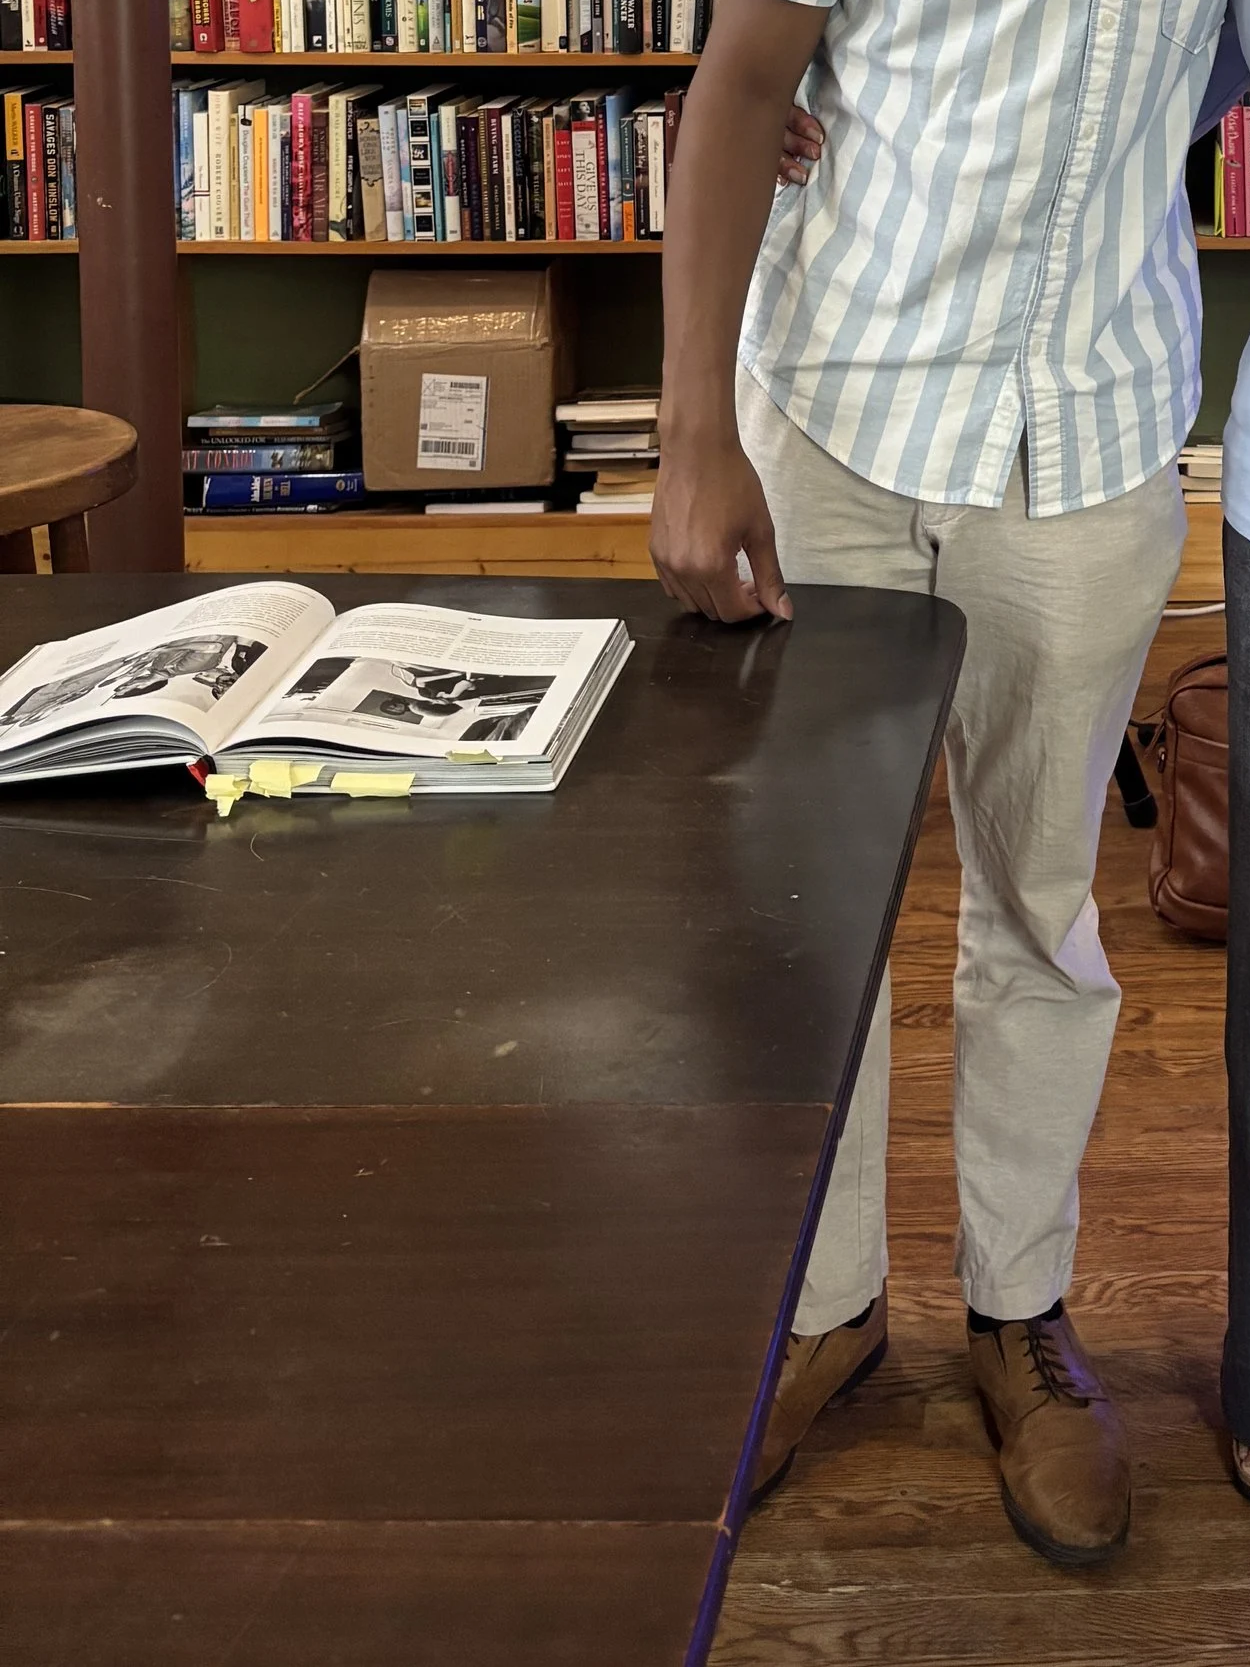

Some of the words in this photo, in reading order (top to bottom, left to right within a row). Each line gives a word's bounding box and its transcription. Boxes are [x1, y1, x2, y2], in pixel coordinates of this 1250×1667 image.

[46, 114, 56, 155] SAVAGES
[242, 130, 250, 154] Douglas
[47, 158, 56, 177] DON
[575, 152, 586, 182] THIS
[585, 161, 596, 192] GIVE
[48, 182, 58, 222] WINSLOW
[577, 184, 587, 210] DAY
[587, 194, 597, 211] US
